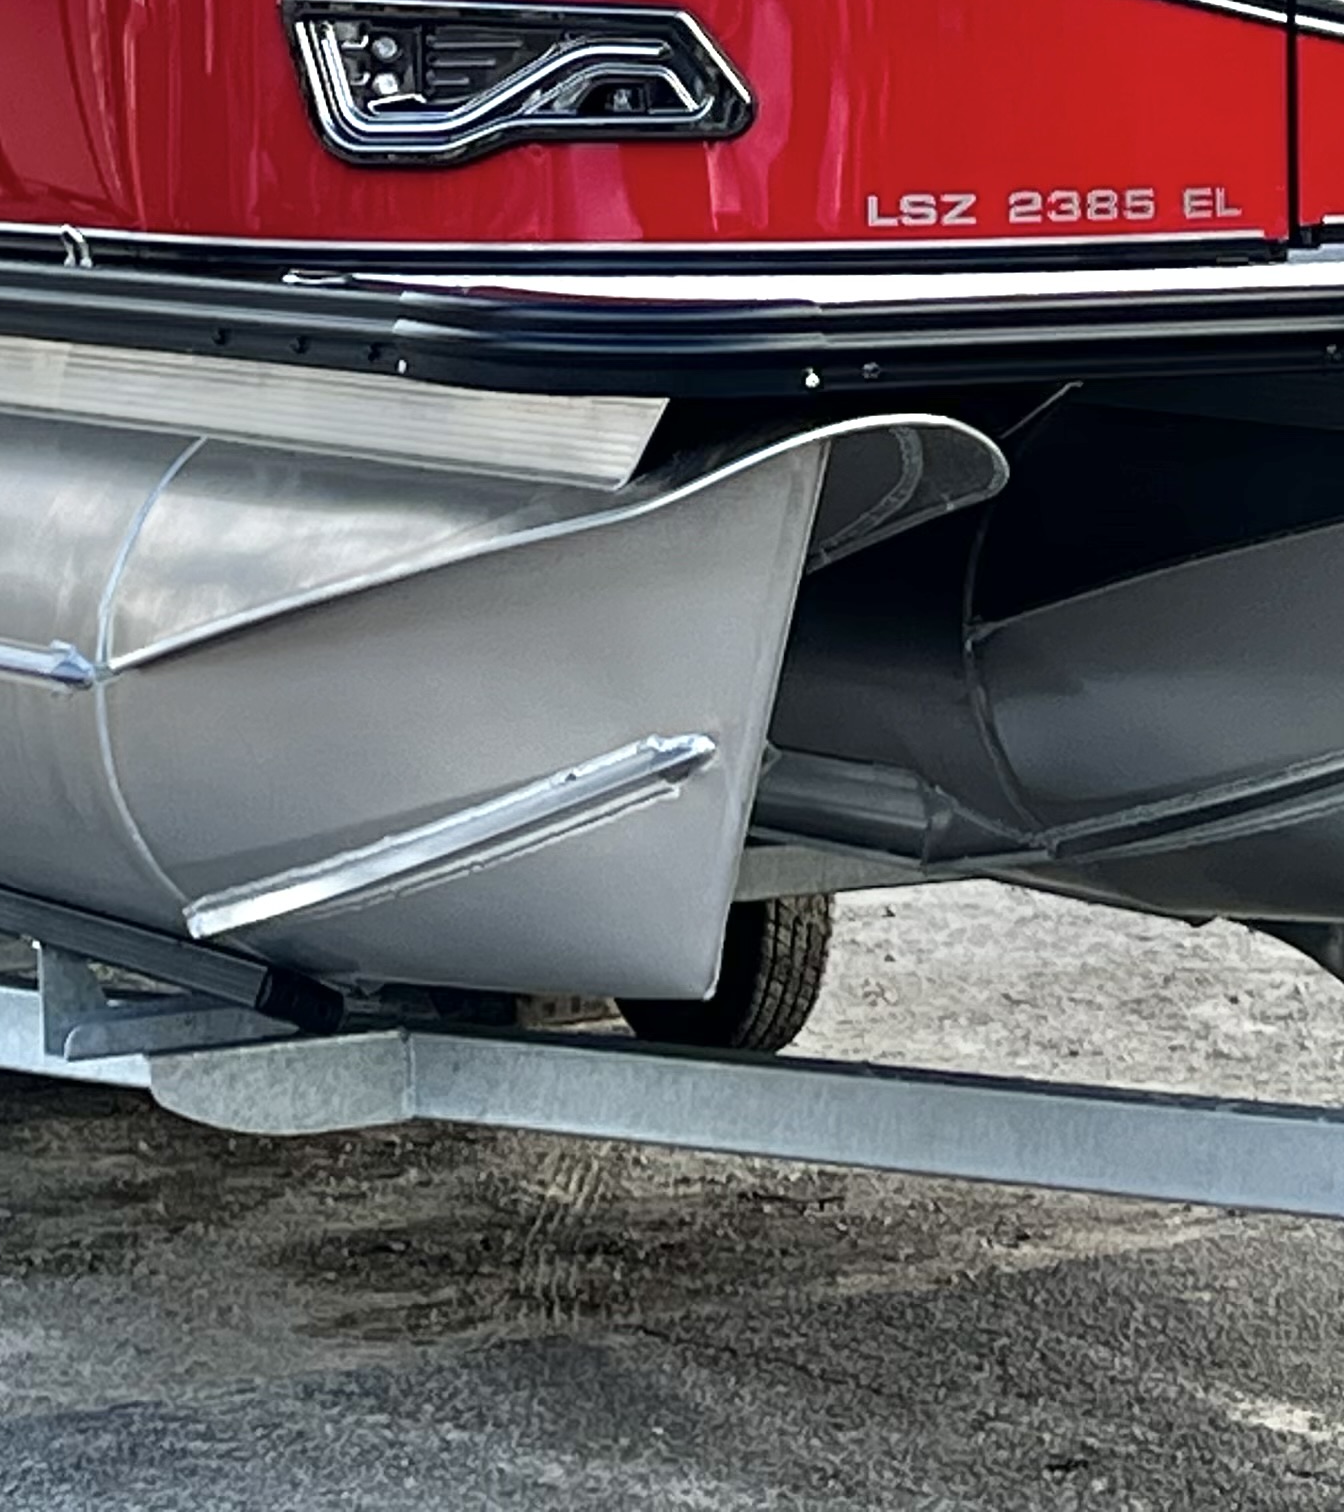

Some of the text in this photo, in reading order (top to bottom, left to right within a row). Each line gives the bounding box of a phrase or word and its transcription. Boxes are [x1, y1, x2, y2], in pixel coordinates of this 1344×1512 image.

[867, 187, 1242, 227] LSZ 2385 EL
